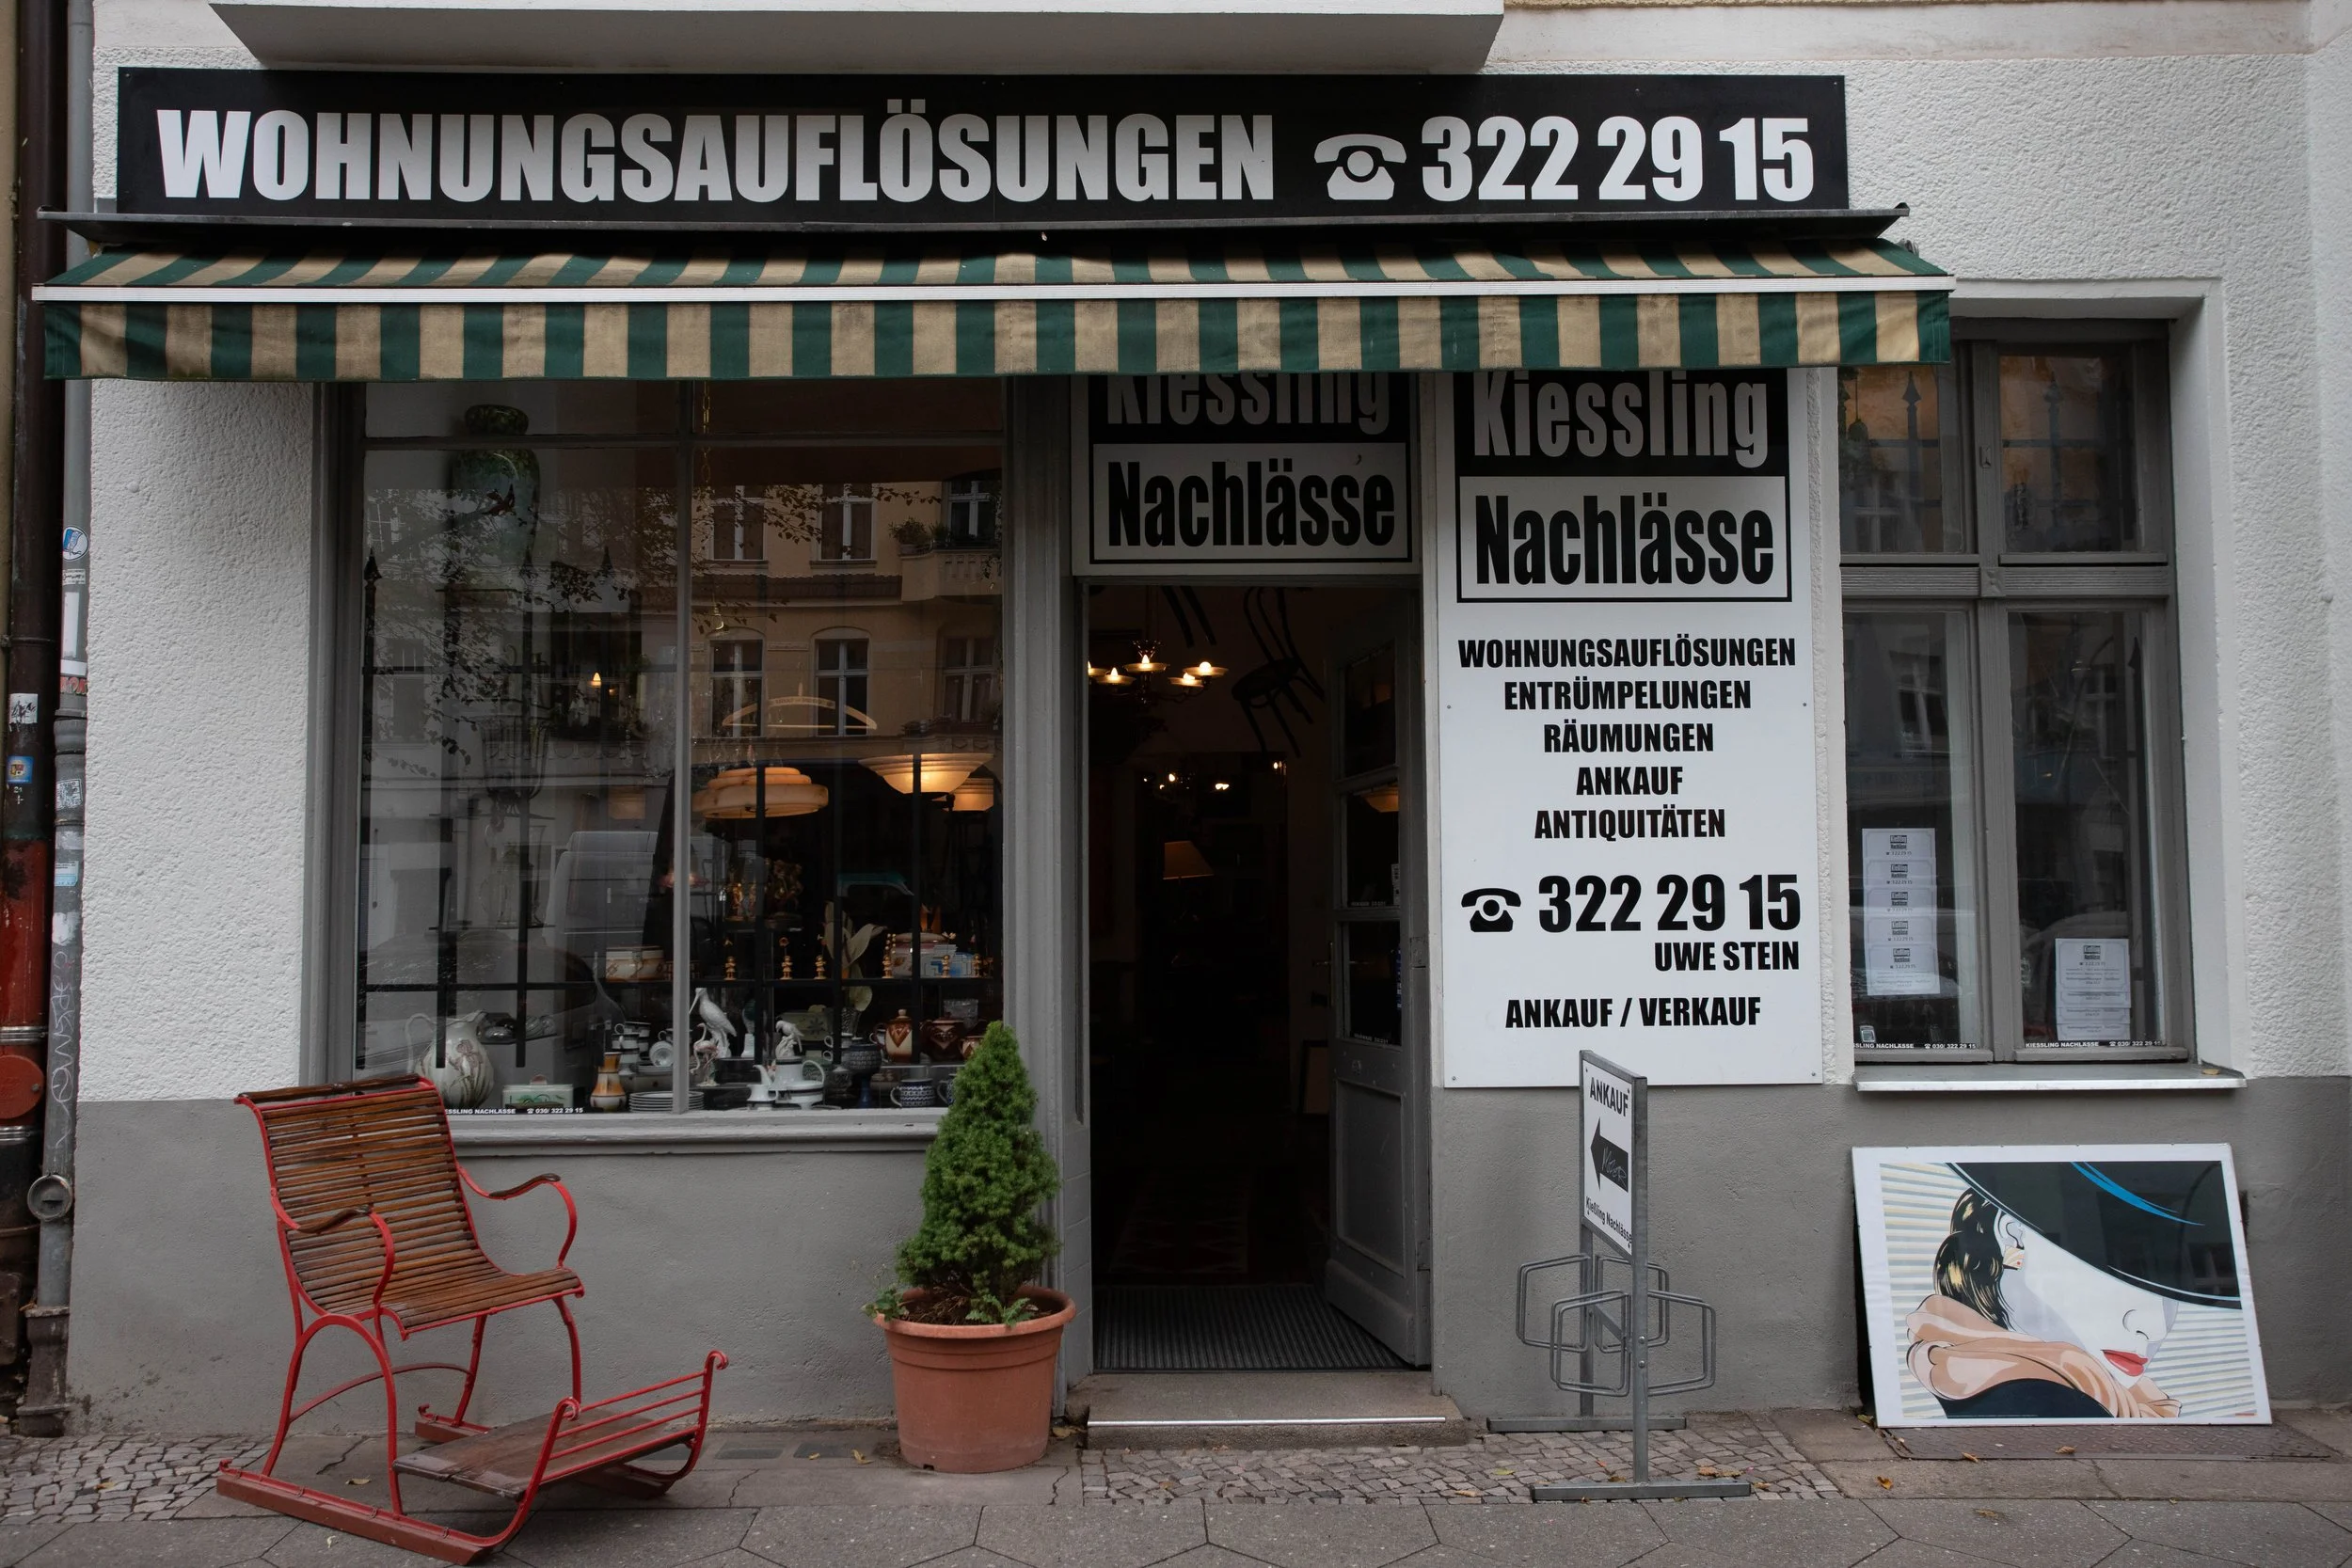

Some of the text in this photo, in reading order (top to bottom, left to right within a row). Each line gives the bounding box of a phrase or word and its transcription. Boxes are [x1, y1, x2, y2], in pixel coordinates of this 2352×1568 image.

[157, 98, 1814, 203] WOHNUNGSAUFLÖSUNGEN 322 29 15
[1473, 371, 1769, 468] Kiessling
[1107, 457, 1395, 547] Nachlässe
[1475, 491, 1774, 586] Nachlässe
[1457, 633, 1796, 669] WOHNUNGSAUFLÖSUNGEN
[1504, 675, 1752, 710] ENTRÜMPELUNGEN
[1544, 719, 1714, 753] RÄUMUNGEN
[1576, 766, 1683, 796] ANKAUF
[1534, 803, 1725, 842] ANTIQUITÄTEN
[1538, 873, 1801, 933] 322 29 15
[1654, 941, 1800, 972] UWE STEIN
[1505, 996, 1761, 1029] ANKAUF / VERKAUF
[1589, 1076, 1629, 1117] ANKAUF
[1585, 1196, 1632, 1243] Kießling Nachlässe
